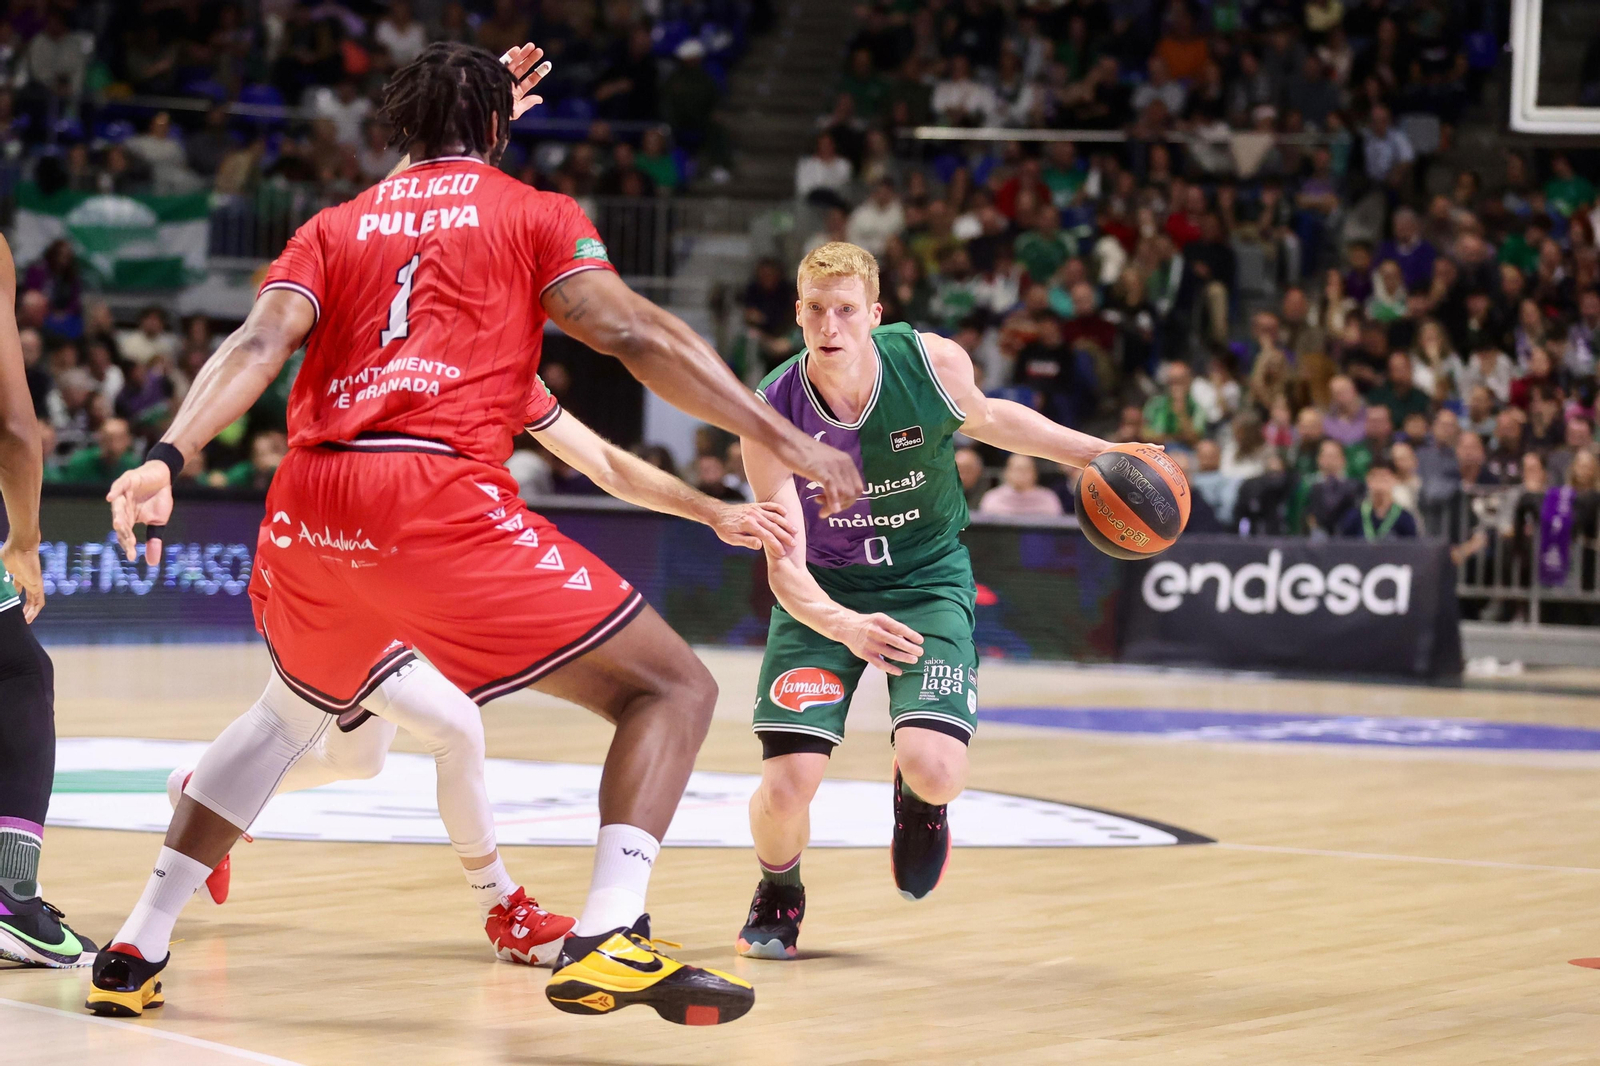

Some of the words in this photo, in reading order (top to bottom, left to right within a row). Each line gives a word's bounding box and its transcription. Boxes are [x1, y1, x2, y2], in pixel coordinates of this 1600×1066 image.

[375, 173, 480, 205] FELICIO
[356, 204, 480, 241] PULEVA
[380, 253, 420, 348] 1
[333, 393, 350, 409] E
[895, 437, 922, 449] endesa
[862, 470, 926, 495] Unicaja
[1111, 456, 1176, 524] SPALDING
[828, 508, 920, 529] málaga
[1087, 482, 1126, 530] endesa
[298, 520, 380, 552] Andalucía
[1122, 527, 1150, 548] liga
[1141, 548, 1412, 616] endesa
[924, 657, 945, 665] sabor
[930, 663, 964, 682] má
[776, 671, 842, 700] famadesa
[921, 673, 963, 695] laga
